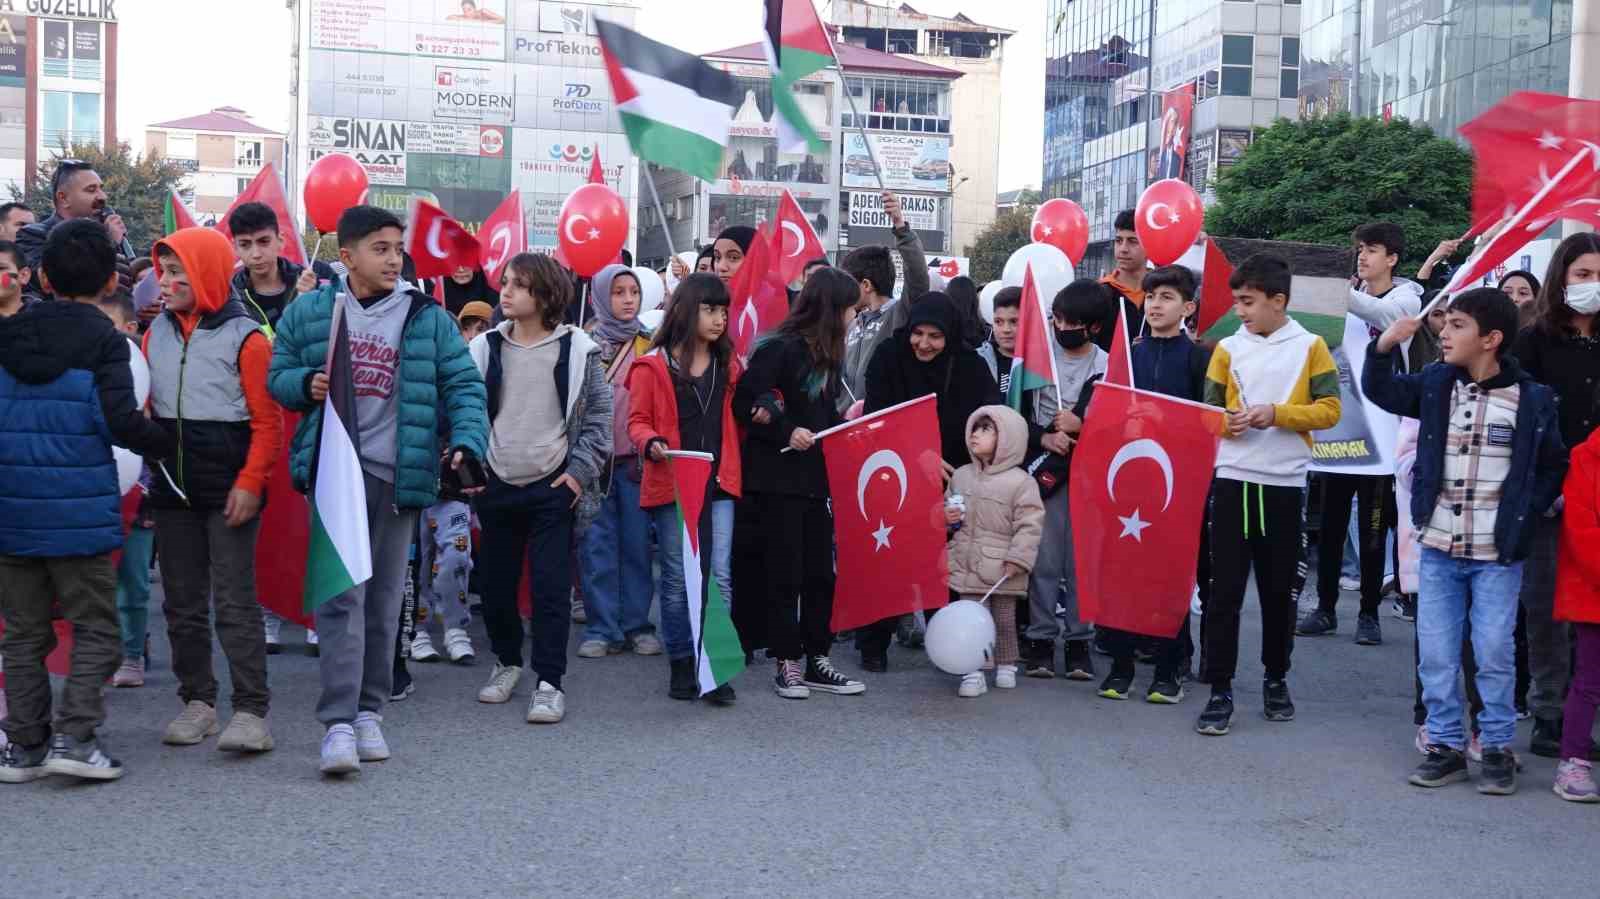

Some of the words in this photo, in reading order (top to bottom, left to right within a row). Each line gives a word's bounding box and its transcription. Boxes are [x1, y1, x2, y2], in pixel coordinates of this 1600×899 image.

[437, 91, 512, 108] MODERN
[553, 98, 602, 111] ProfDent
[334, 118, 405, 151] SİNAN
[729, 126, 761, 136] asyon
[853, 194, 883, 209] ADEM
[897, 196, 935, 213] RAKAŞ
[349, 340, 400, 368] perior
